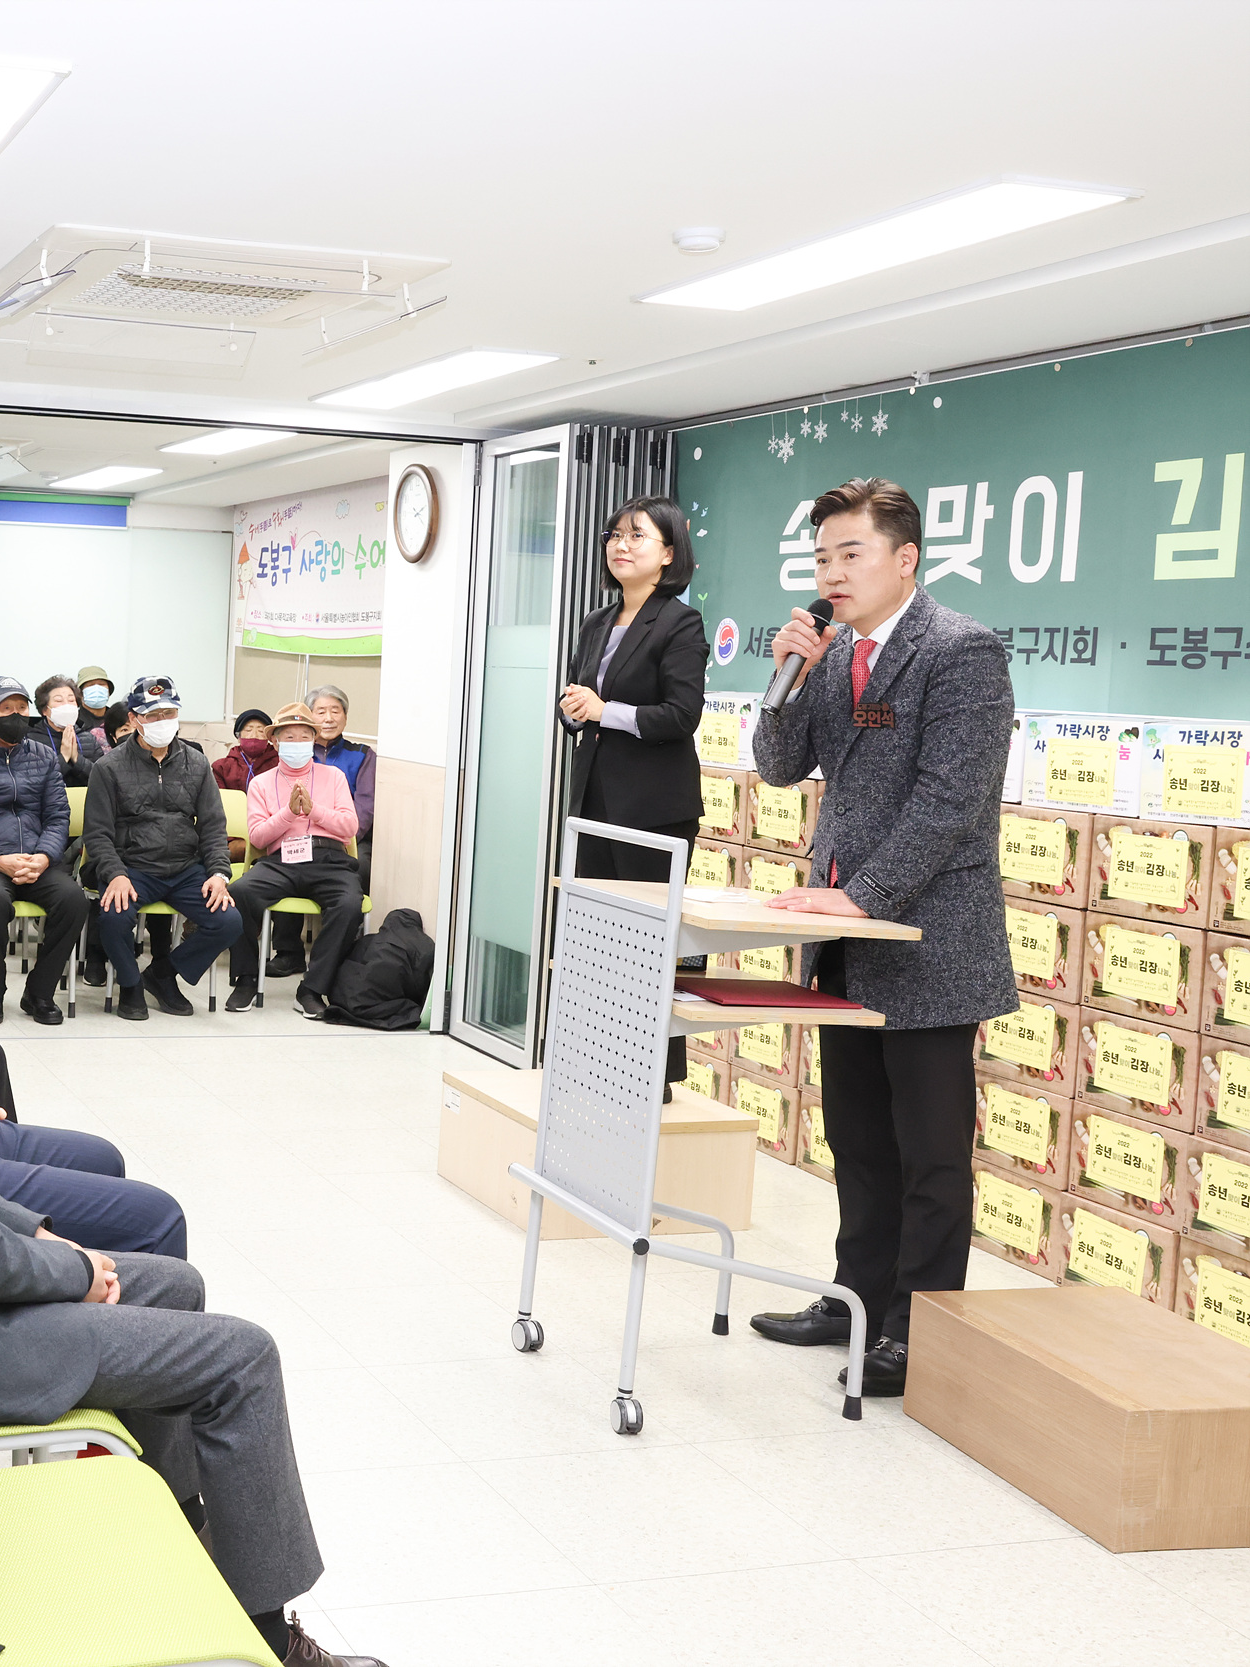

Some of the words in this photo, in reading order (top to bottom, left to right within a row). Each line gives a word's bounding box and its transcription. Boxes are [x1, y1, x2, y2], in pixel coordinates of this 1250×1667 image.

[779, 471, 1084, 591] 송맞이
[257, 540, 292, 587] 도봉구
[299, 540, 345, 582] 사랑의
[1147, 626, 1250, 670] 도봉구
[705, 701, 735, 714] 가락시장
[852, 710, 895, 729] 오언석
[1056, 724, 1110, 741] 가락시장
[1179, 730, 1243, 748] 가락시장
[1193, 767, 1207, 775] 2022
[1139, 851, 1154, 859] 2022
[1016, 924, 1028, 932] 2022
[1132, 947, 1146, 956] 2022
[1124, 1044, 1138, 1053] 2022
[1227, 1082, 1250, 1099] 송년
[1010, 1107, 1021, 1116] 2022
[1117, 1139, 1130, 1148] 2022
[1234, 1179, 1249, 1189] 2022
[1001, 1199, 1013, 1209] 2022
[1100, 1239, 1112, 1249] 2022
[1228, 1294, 1243, 1305] 2022
